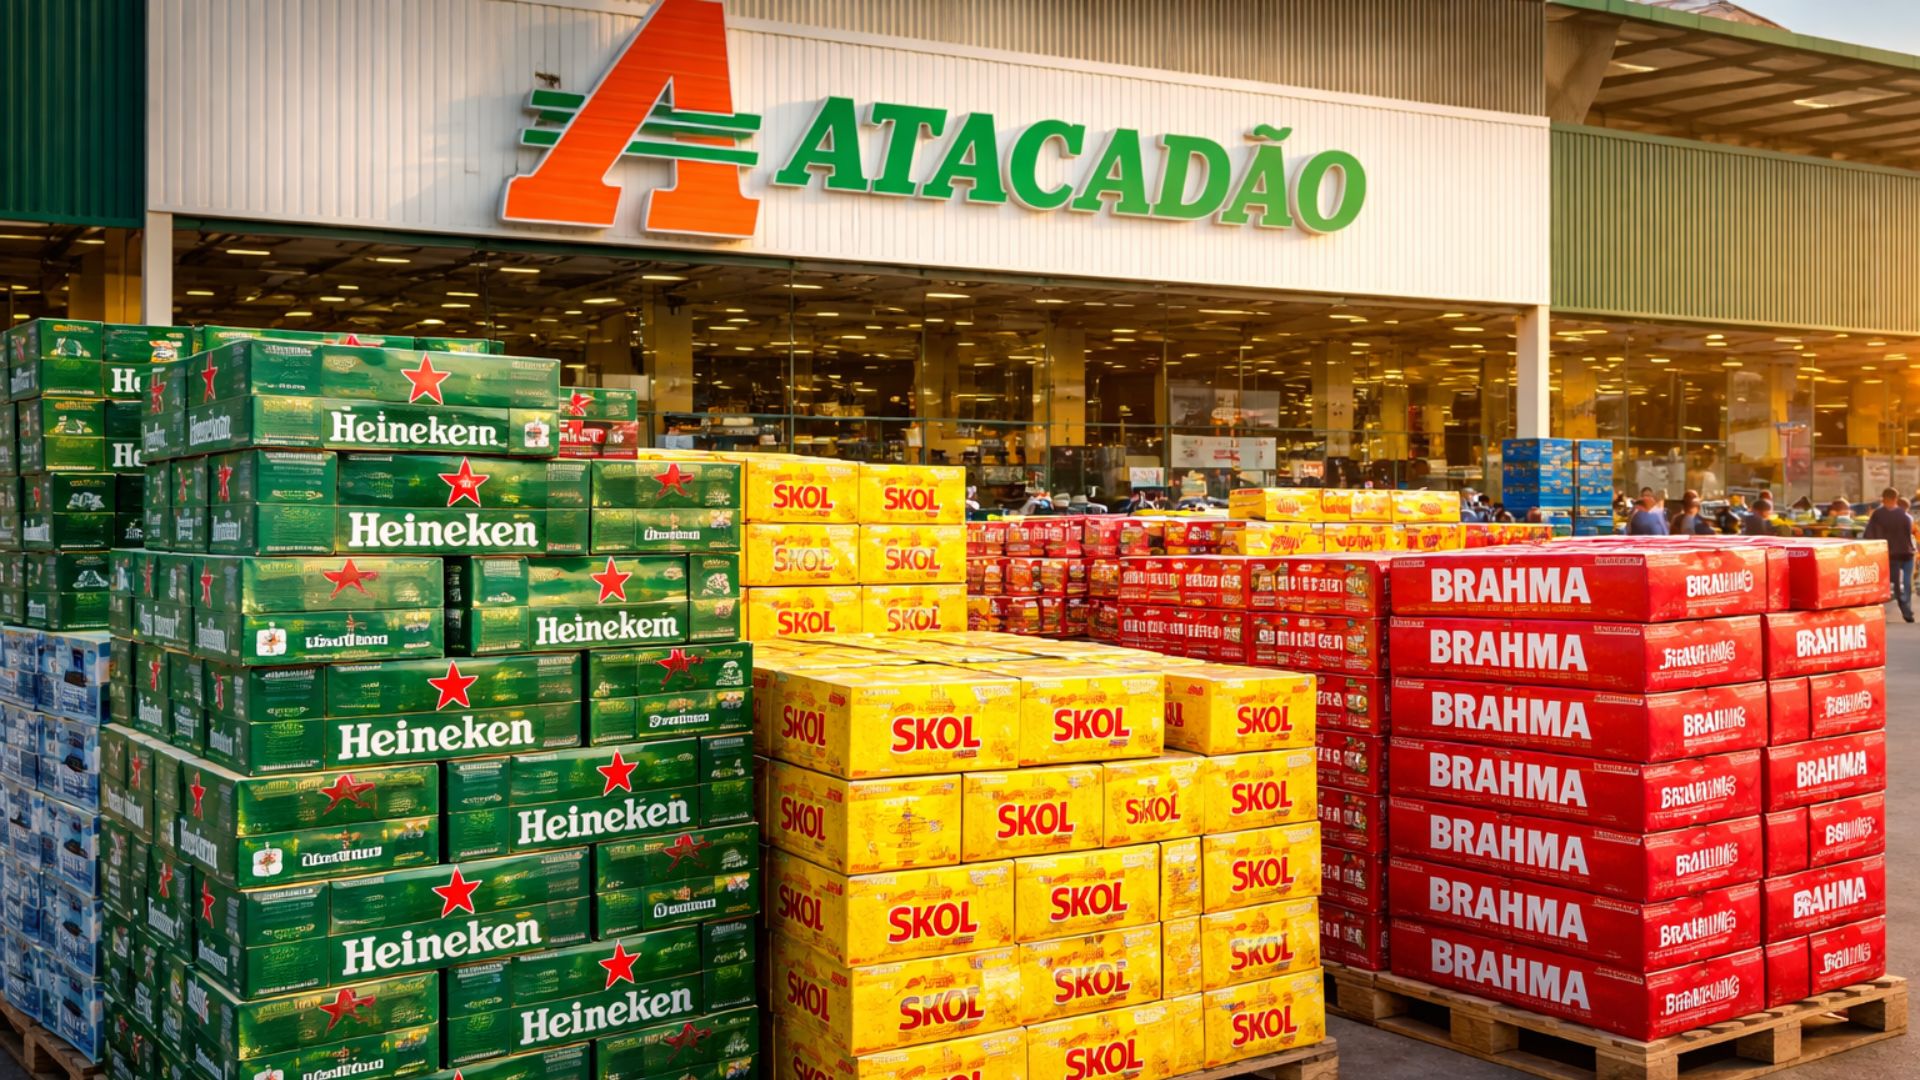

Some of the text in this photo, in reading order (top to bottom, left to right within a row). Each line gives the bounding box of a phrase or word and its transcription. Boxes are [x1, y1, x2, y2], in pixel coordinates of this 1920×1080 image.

[776, 97, 1367, 233] ATACADÃO
[774, 484, 833, 509] SKOL
[884, 487, 940, 511] SKOL
[348, 512, 539, 547] Heineken
[885, 549, 940, 571] SKOL
[1431, 566, 1591, 604] BRAHMA
[777, 611, 835, 635] SKOL
[887, 607, 940, 632] SKOL
[1430, 629, 1588, 672] BRAHMA
[782, 705, 826, 747] SKOL
[892, 715, 981, 753] SKOL
[1053, 707, 1130, 742] SKOL
[1237, 705, 1293, 735] SKOL
[1431, 691, 1592, 740] BRAHMA
[338, 715, 535, 761] Heineken
[1231, 781, 1293, 816] SKOL
[1429, 752, 1588, 808] BRAHMA
[517, 798, 691, 845] Heineken
[780, 796, 826, 841] SKOL
[997, 802, 1075, 840] SKOL
[1430, 814, 1589, 876] BRAHMA
[1232, 857, 1295, 892] SKOL
[779, 884, 824, 932] SKOL
[888, 901, 978, 943] SKOL
[1050, 882, 1128, 921] SKOL
[1429, 876, 1588, 943] BRAHMA
[342, 920, 542, 976] Heineken
[1230, 934, 1295, 971] SKOL
[1054, 961, 1131, 1004] SKOL
[1431, 938, 1591, 1010] BRAHMA
[520, 988, 694, 1046] Heineken
[787, 971, 830, 1022] SKOL
[899, 988, 984, 1031] SKOL
[1232, 1006, 1298, 1048] SKOL
[1066, 1039, 1144, 1080] SKOL
